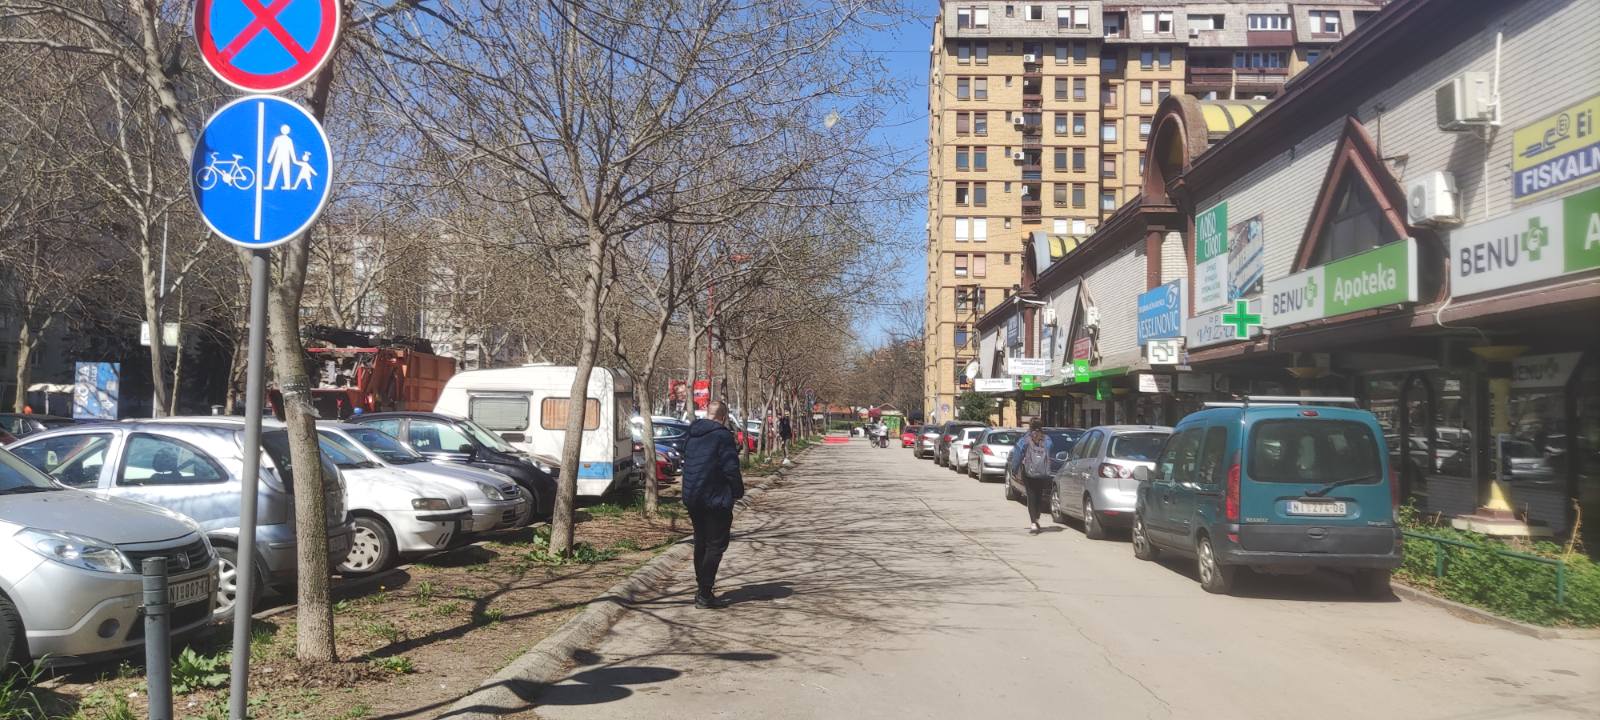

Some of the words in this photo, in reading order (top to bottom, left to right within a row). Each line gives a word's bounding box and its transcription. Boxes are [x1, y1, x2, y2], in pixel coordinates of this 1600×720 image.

[1576, 108, 1593, 139] Ei
[1460, 233, 1519, 278] BENU
[1272, 290, 1303, 316] BENU
[1333, 264, 1397, 306] Apoteka
